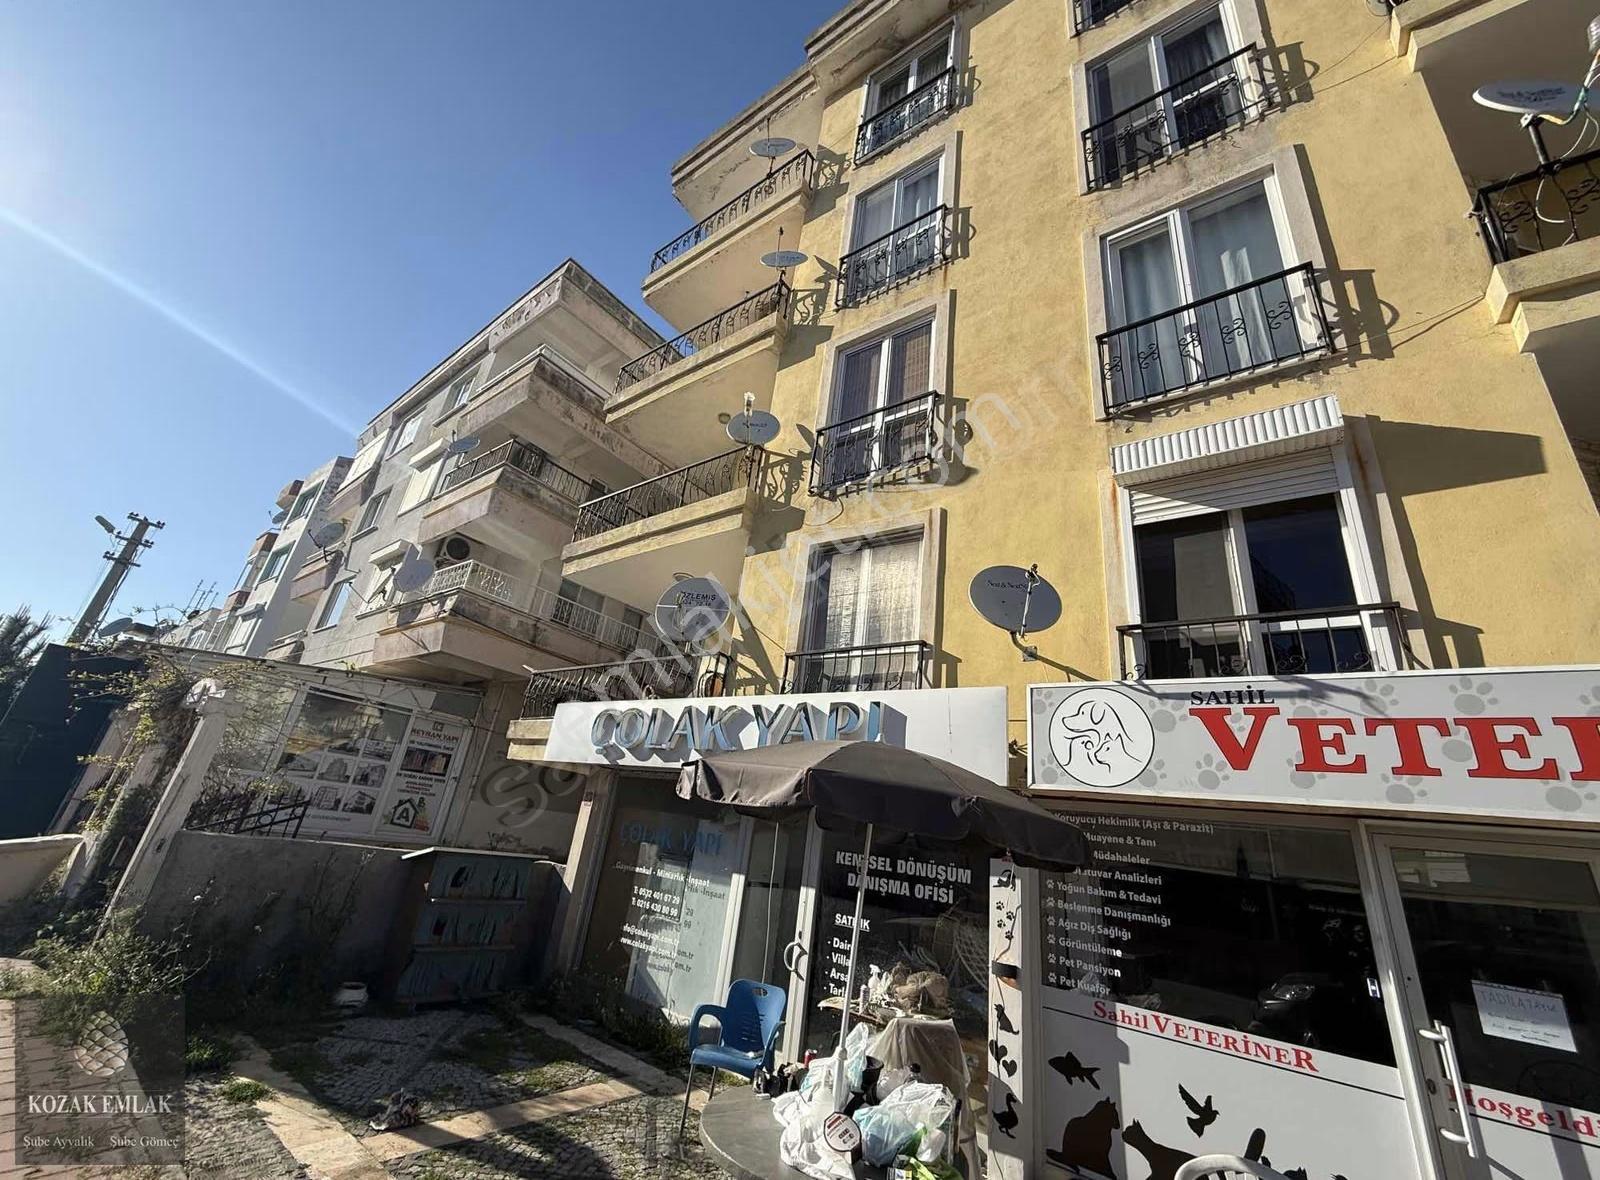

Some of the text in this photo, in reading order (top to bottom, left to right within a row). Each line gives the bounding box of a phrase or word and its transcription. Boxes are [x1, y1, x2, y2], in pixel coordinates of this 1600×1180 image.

[1190, 684, 1275, 706] SAHİL
[591, 701, 883, 755] ÇOLAK YAPI
[1098, 816, 1140, 828] Hekimlik
[1163, 820, 1173, 831] &
[1126, 836, 1134, 845] &
[836, 851, 972, 884] KENSEL DÖNÜŞÜM
[1114, 870, 1162, 885] Analizleri
[914, 882, 954, 904] OFİSİ
[1057, 881, 1161, 904] Yoğun Bakım & Tedavi
[834, 913, 870, 930] SATIIK
[1057, 900, 1171, 927] Beslenme Danışmanlığı
[1058, 918, 1131, 941] Ağız Diş Sağlığı
[833, 937, 852, 950] Dair
[1058, 937, 1122, 958] Görüntüleme
[1059, 956, 1121, 977] Pet Pansiyon
[829, 983, 846, 997] Tarl
[1060, 976, 1111, 995] Pet Kuaför
[1094, 1001, 1319, 1072] Sahil VETERİNER
